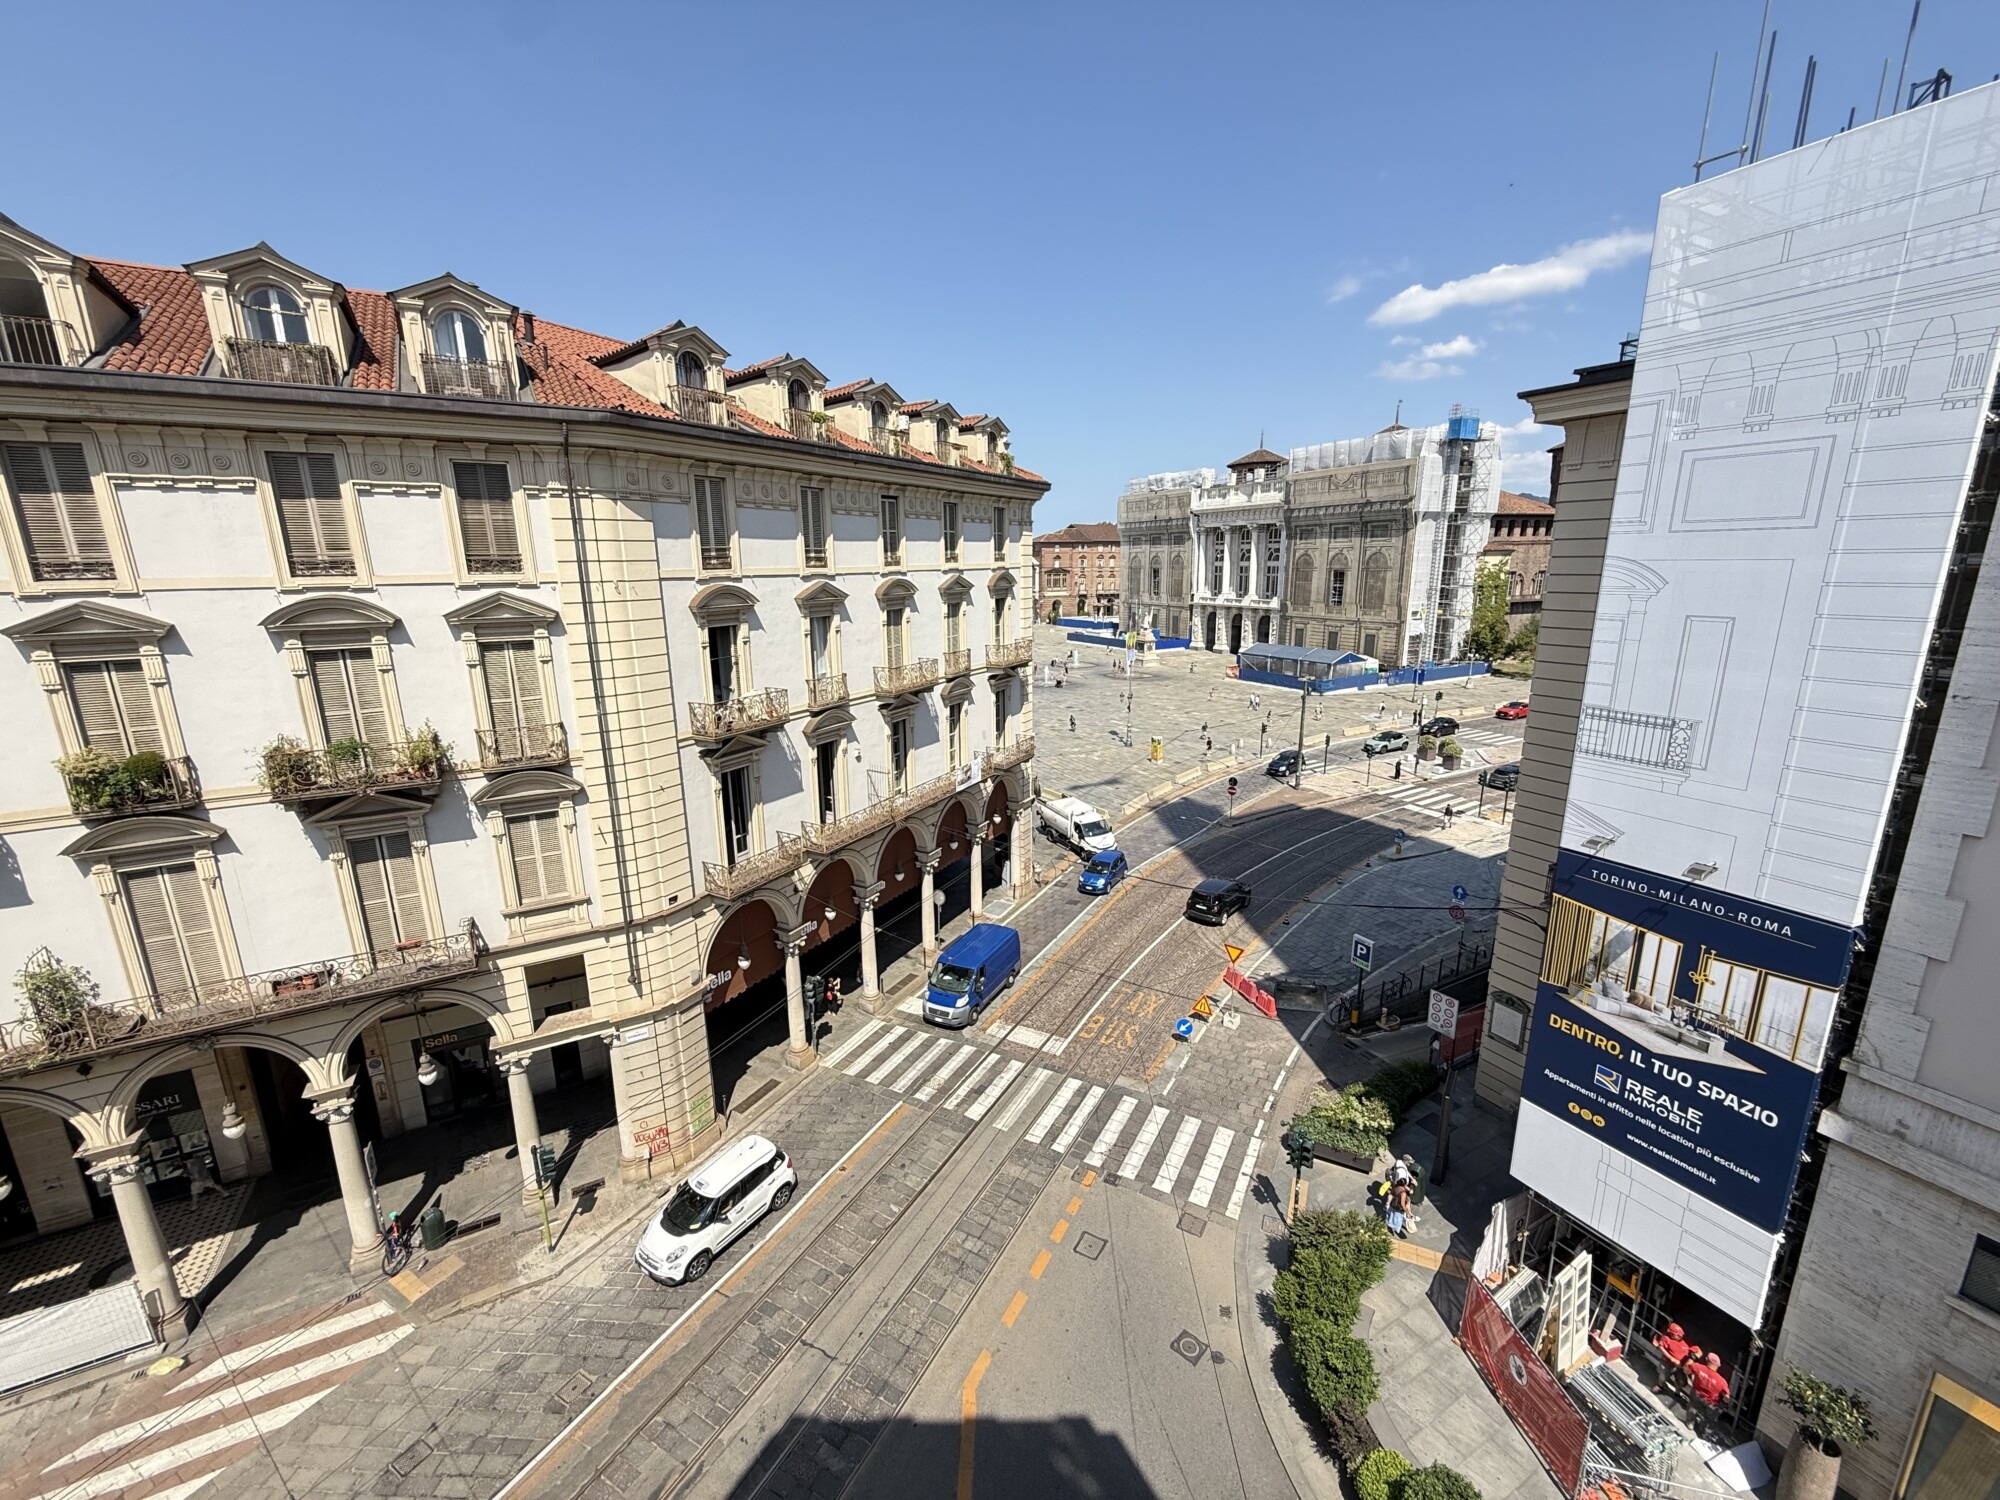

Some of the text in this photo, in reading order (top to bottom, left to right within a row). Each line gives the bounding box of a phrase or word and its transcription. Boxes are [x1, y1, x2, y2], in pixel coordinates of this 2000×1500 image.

[801, 920, 818, 936] ella
[1357, 944, 1367, 957] P
[424, 1033, 458, 1049] Sella
[1079, 1013, 1140, 1052] BUS
[1548, 1013, 1624, 1061] DENTRO,
[1629, 1049, 1646, 1069] IL
[1650, 1058, 1694, 1088] TUO
[1696, 1080, 1780, 1128] SPAZIO
[1624, 1090, 1701, 1135] IMMOBILI
[1625, 1077, 1704, 1126] REALE
[639, 1120, 649, 1130] CI
[1543, 1067, 1761, 1184] Appartamenti in affitto nelle location più esclusive
[1626, 1133, 1717, 1185] www.realeimmobili.it
